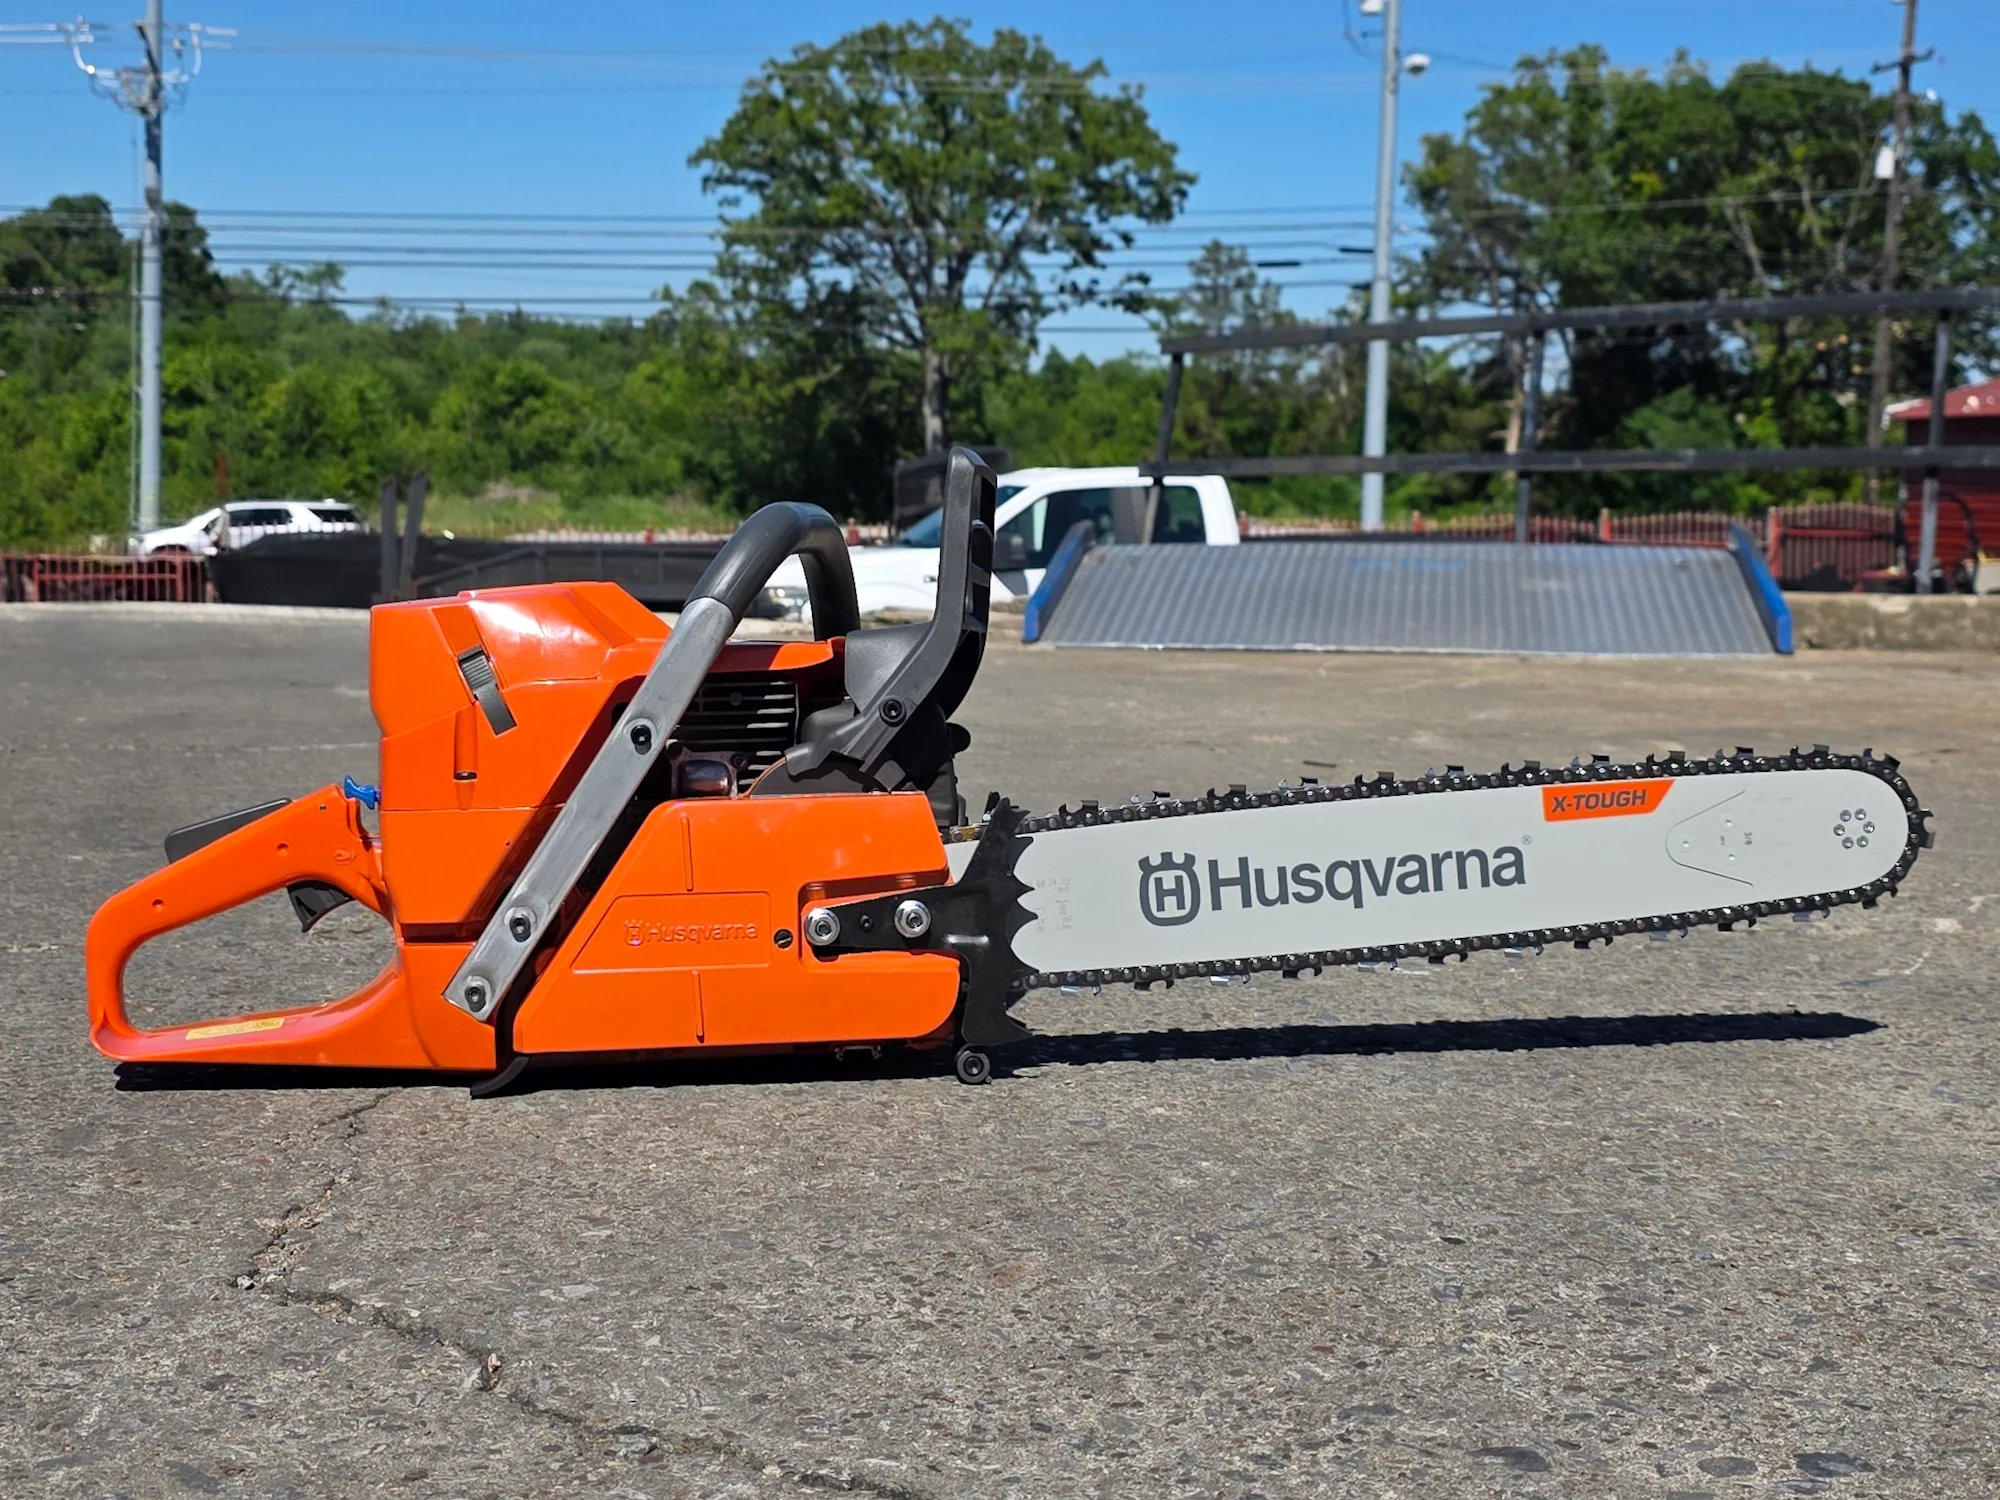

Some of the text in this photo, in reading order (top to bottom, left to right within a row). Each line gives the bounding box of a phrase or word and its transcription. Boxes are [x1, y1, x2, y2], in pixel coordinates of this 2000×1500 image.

[1551, 789, 1647, 813] X-TOUGH
[1207, 845, 1527, 912] Husqvarna
[646, 922, 758, 944] Husqvarna
